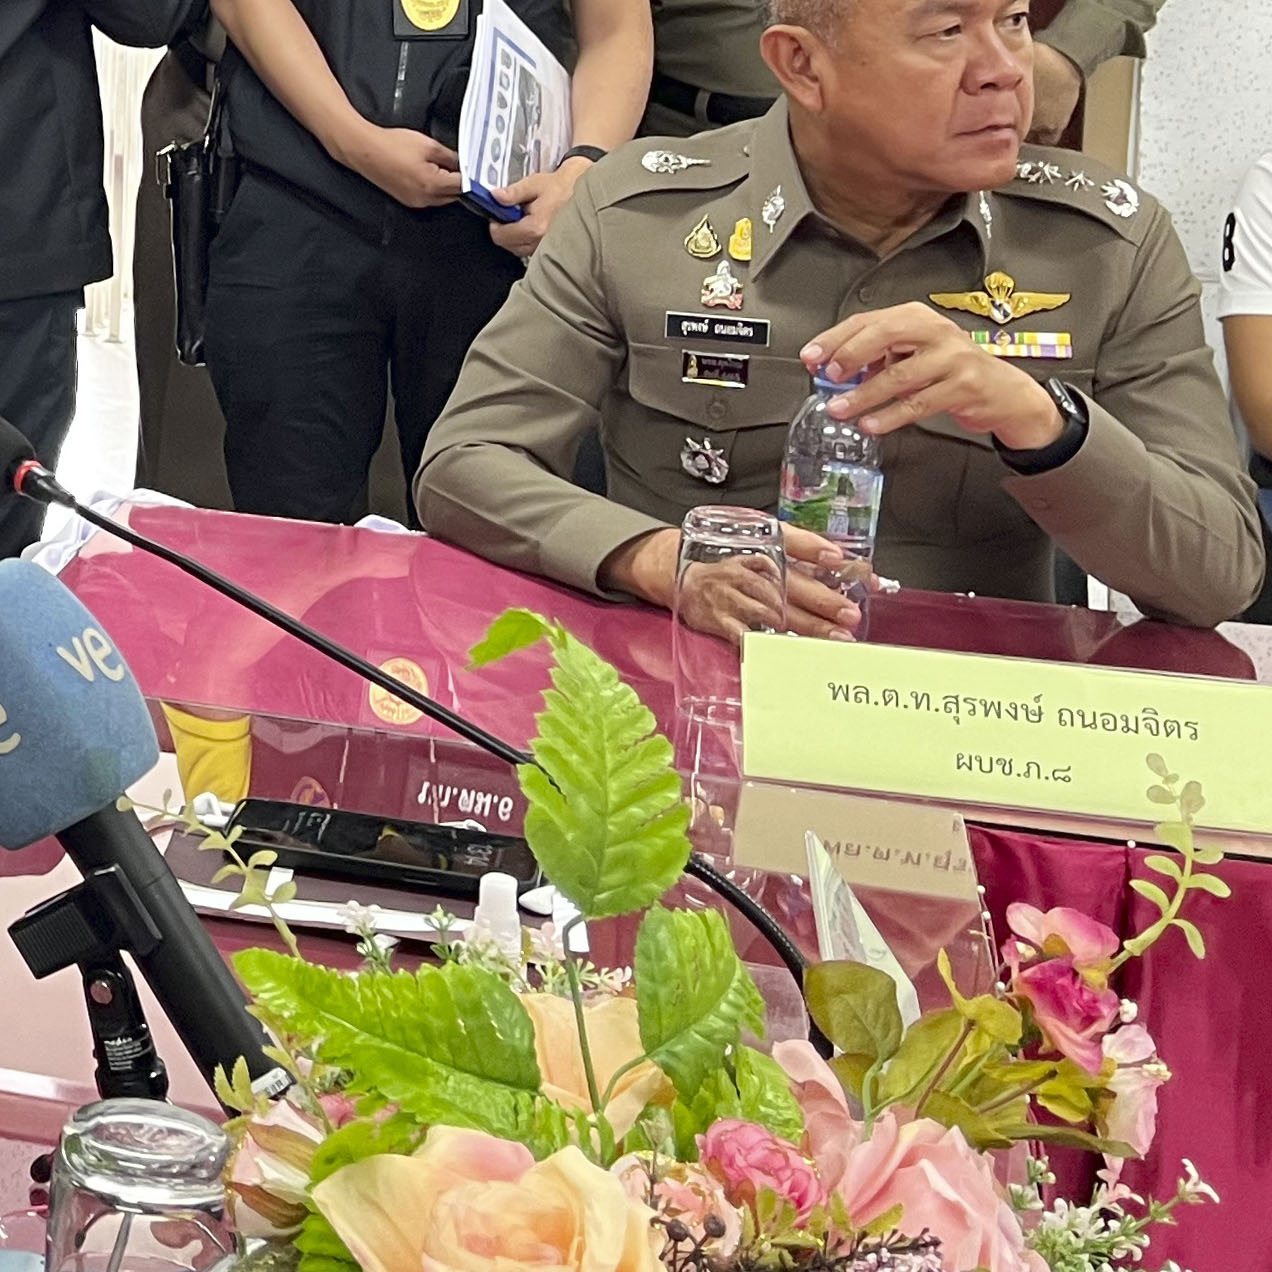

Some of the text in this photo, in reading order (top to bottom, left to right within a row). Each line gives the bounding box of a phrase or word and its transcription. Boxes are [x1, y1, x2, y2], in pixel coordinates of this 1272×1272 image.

[826, 678, 1200, 743] พล.ต.ท.สุรพงษ์ ถนอมจิตร
[955, 749, 1073, 785] ผบช.ภ.๘
